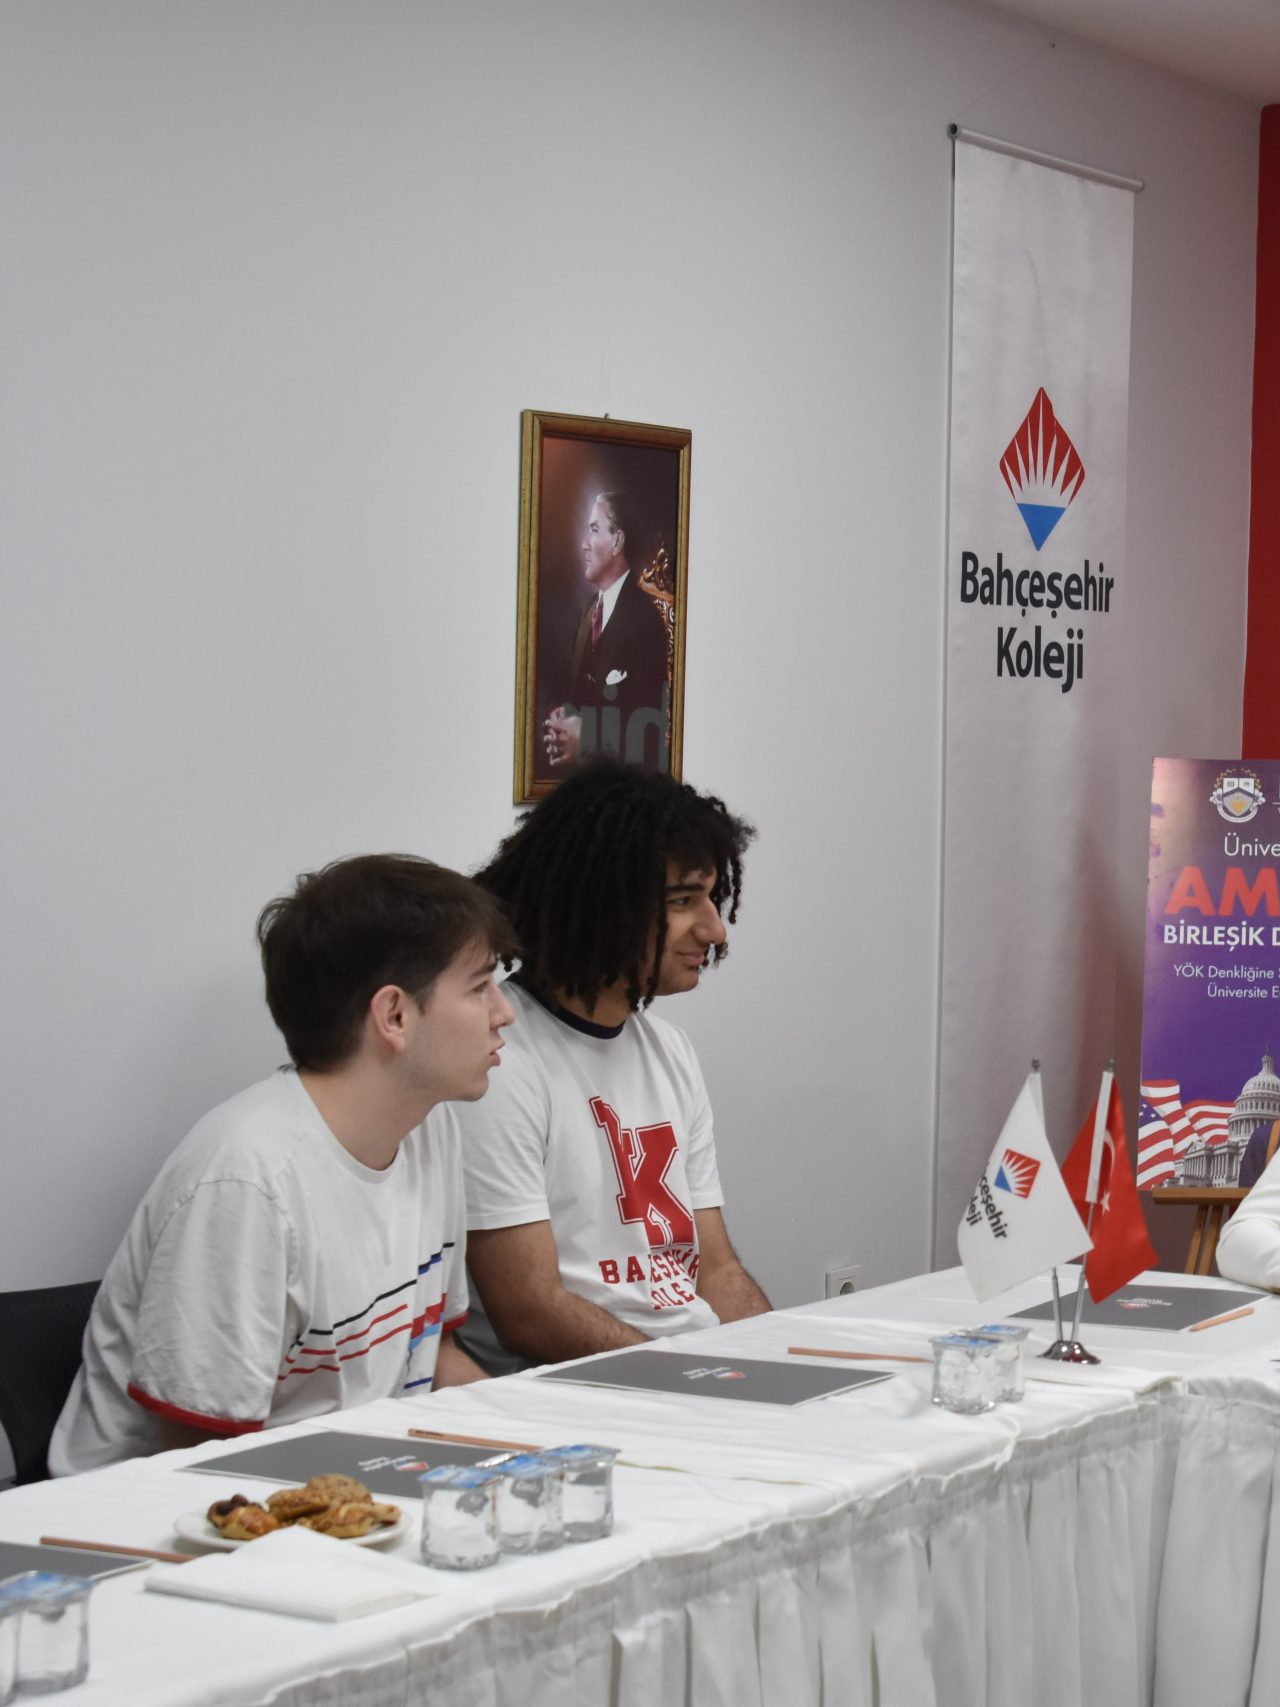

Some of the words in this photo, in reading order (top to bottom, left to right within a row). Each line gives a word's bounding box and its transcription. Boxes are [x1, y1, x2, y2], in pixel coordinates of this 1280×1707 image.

[960, 551, 1115, 619] Bahçeşehir
[997, 625, 1084, 694] Koleji
[1163, 919, 1265, 951] BİRLEŞİK
[1173, 962, 1204, 978] YÖK
[1208, 966, 1275, 981] Denkliğine
[1207, 982, 1268, 999] Üniversite
